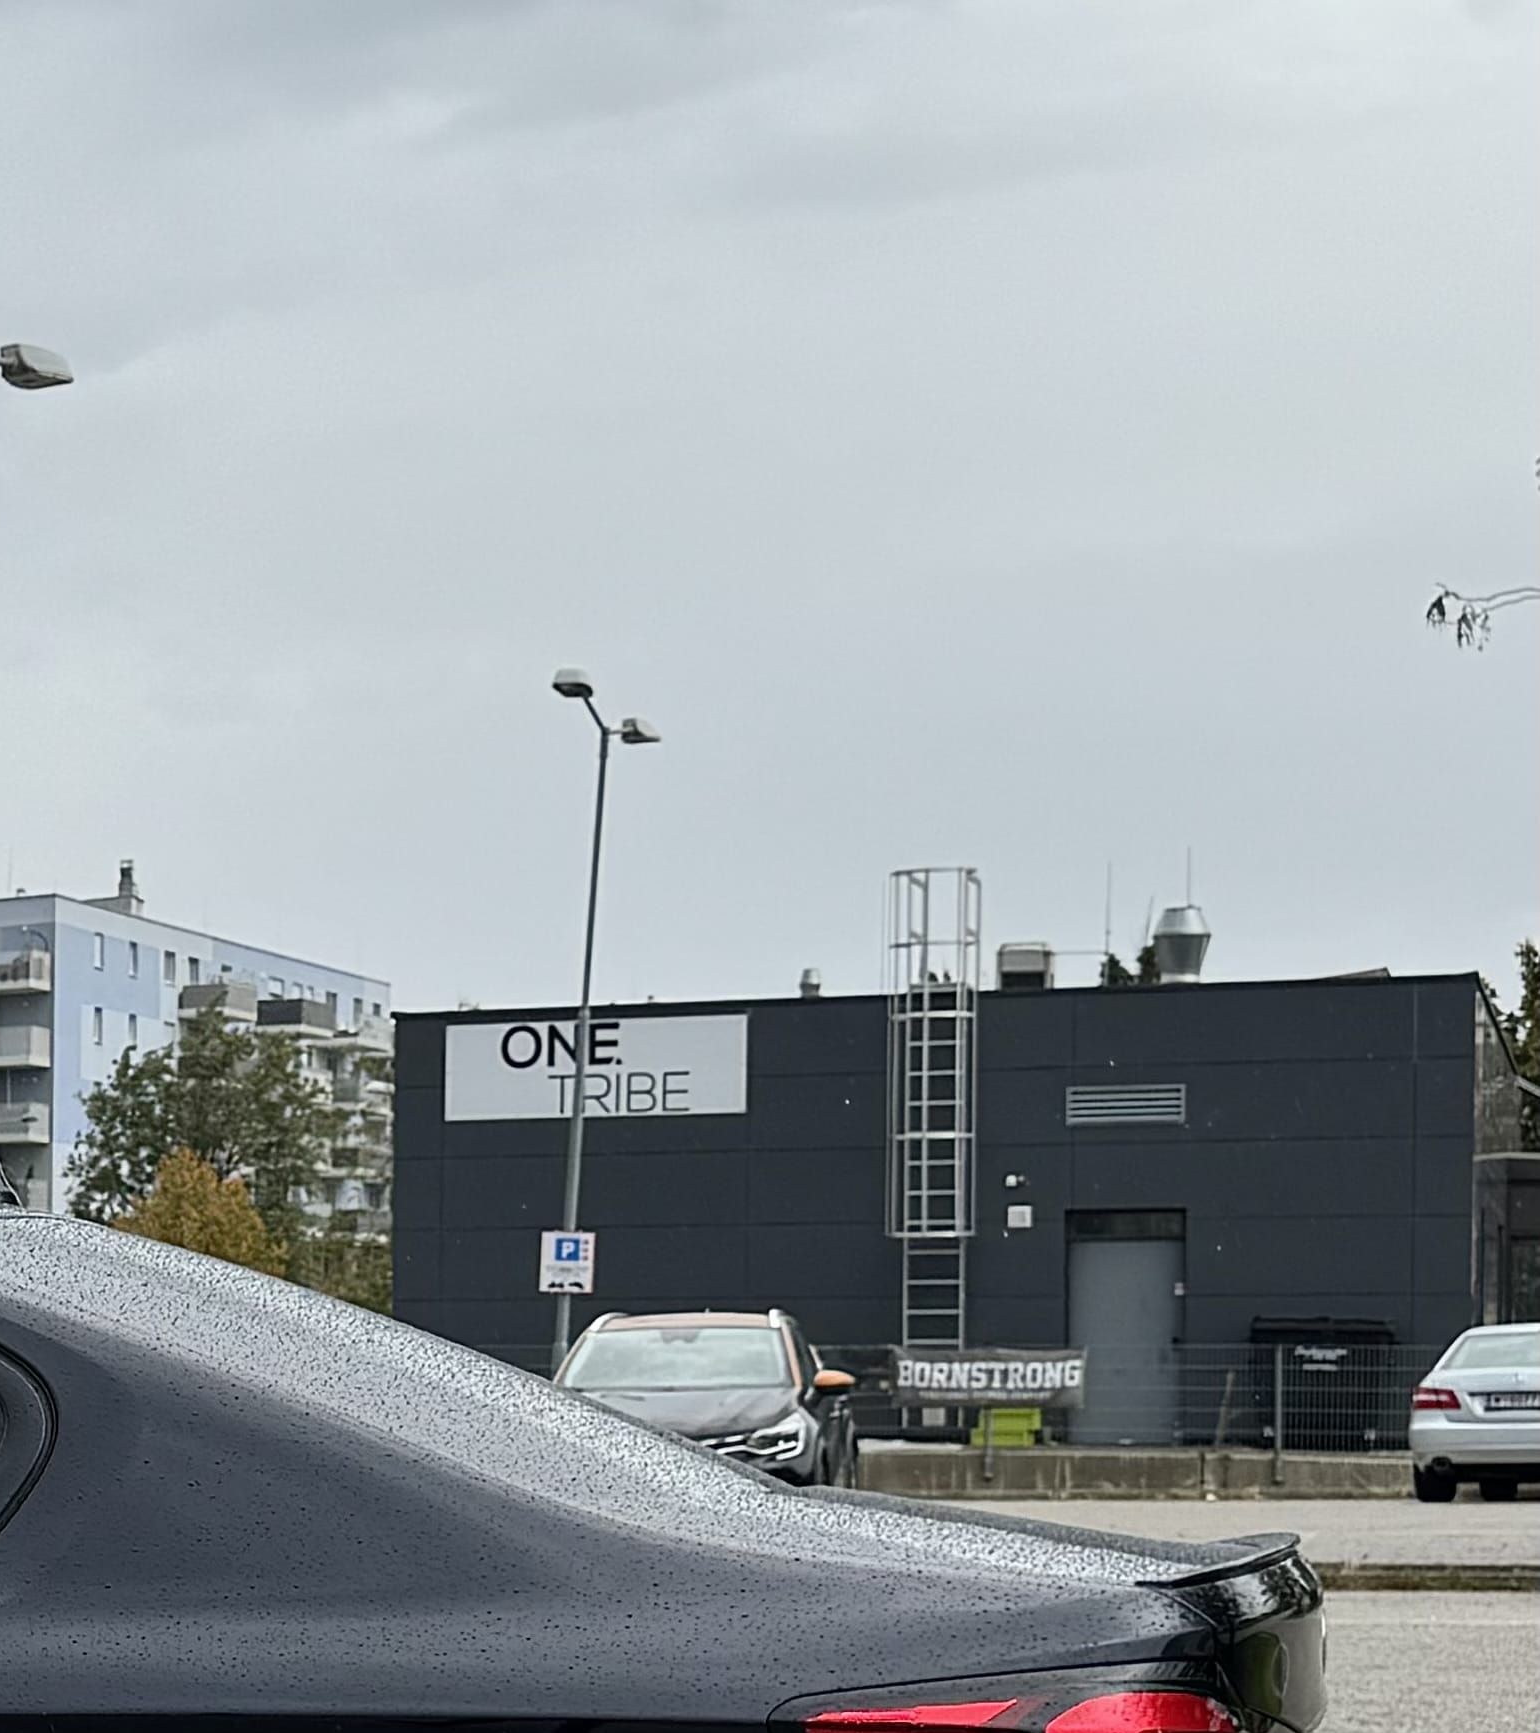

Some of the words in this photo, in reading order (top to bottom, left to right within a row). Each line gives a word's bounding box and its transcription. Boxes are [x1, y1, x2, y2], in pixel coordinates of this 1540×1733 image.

[547, 1070, 690, 1115] TRIBE
[561, 1241, 576, 1259] P
[896, 1358, 1083, 1390] BORNSTRONG
